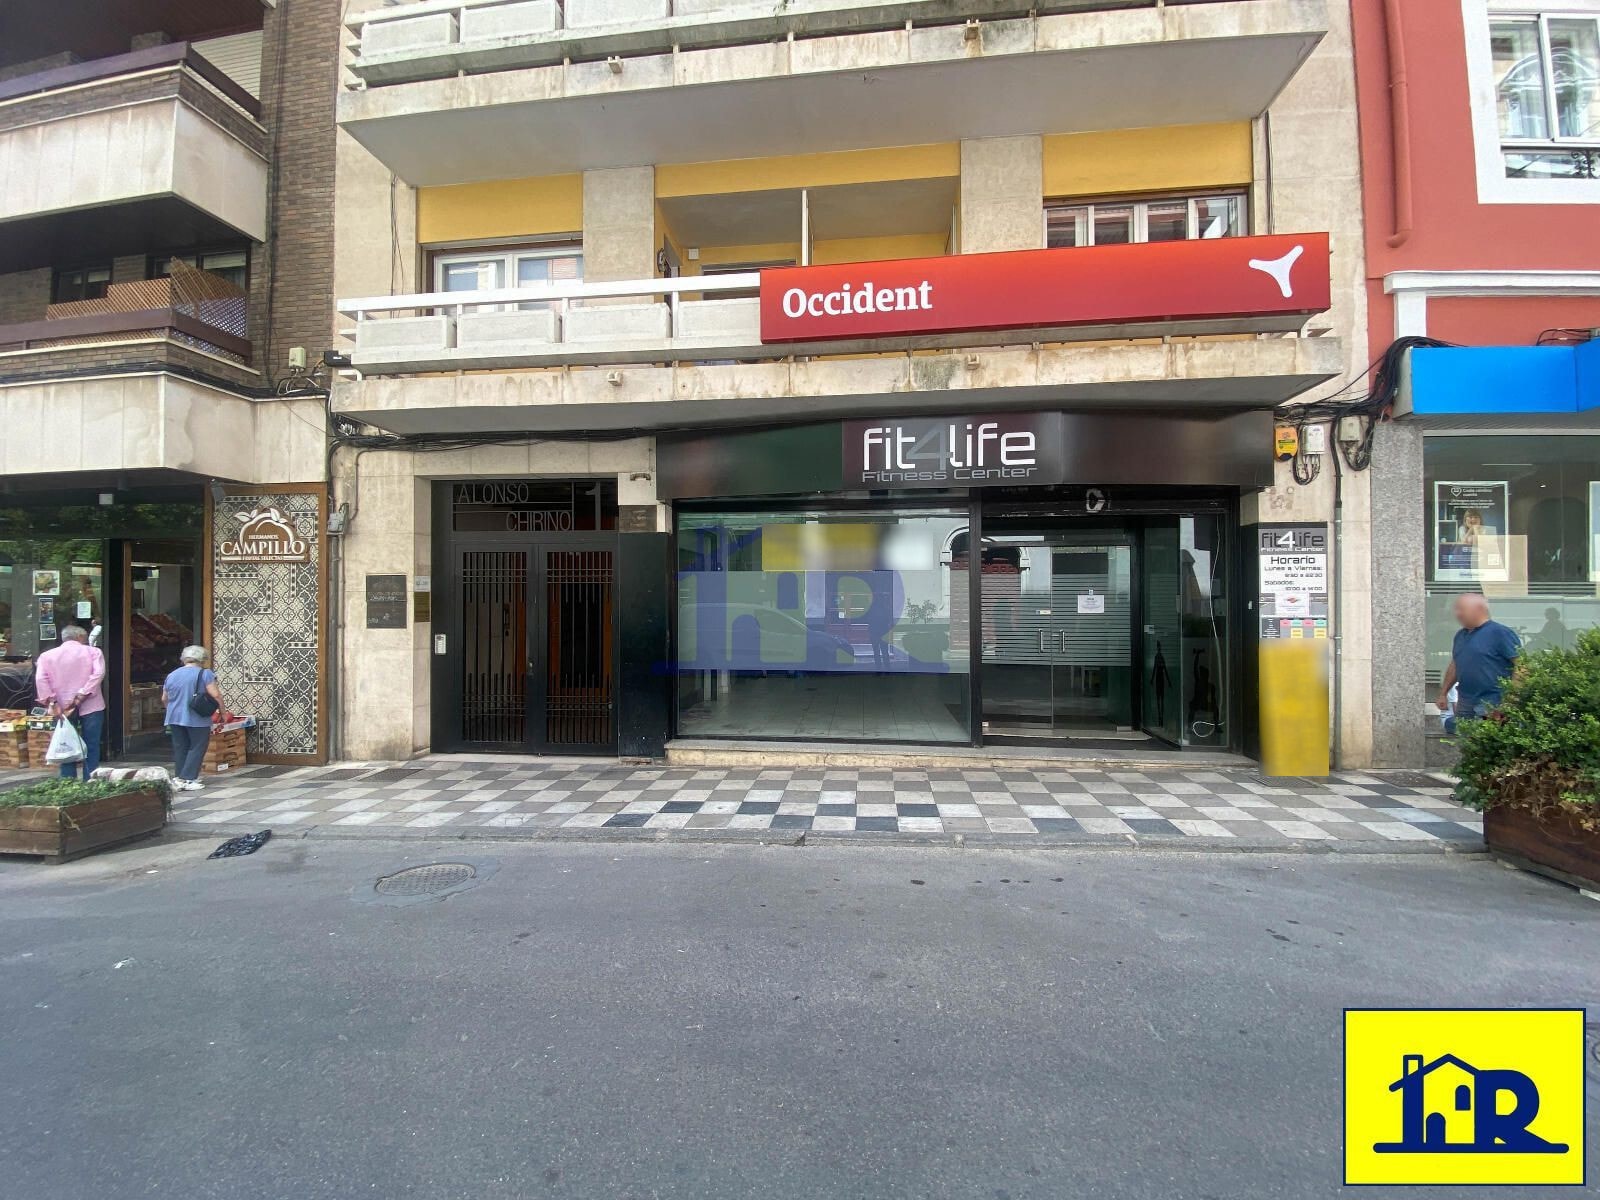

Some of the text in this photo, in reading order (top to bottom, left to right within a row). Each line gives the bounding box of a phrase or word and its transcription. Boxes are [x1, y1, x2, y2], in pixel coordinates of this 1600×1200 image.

[782, 280, 933, 318] Occident
[863, 422, 1036, 471] fit4life
[862, 467, 1038, 483] Fitness Center
[458, 483, 529, 504] ALONSO
[506, 511, 572, 531] CHIRINO
[220, 540, 305, 555] CAMPILLO
[1270, 556, 1316, 565] Horario
